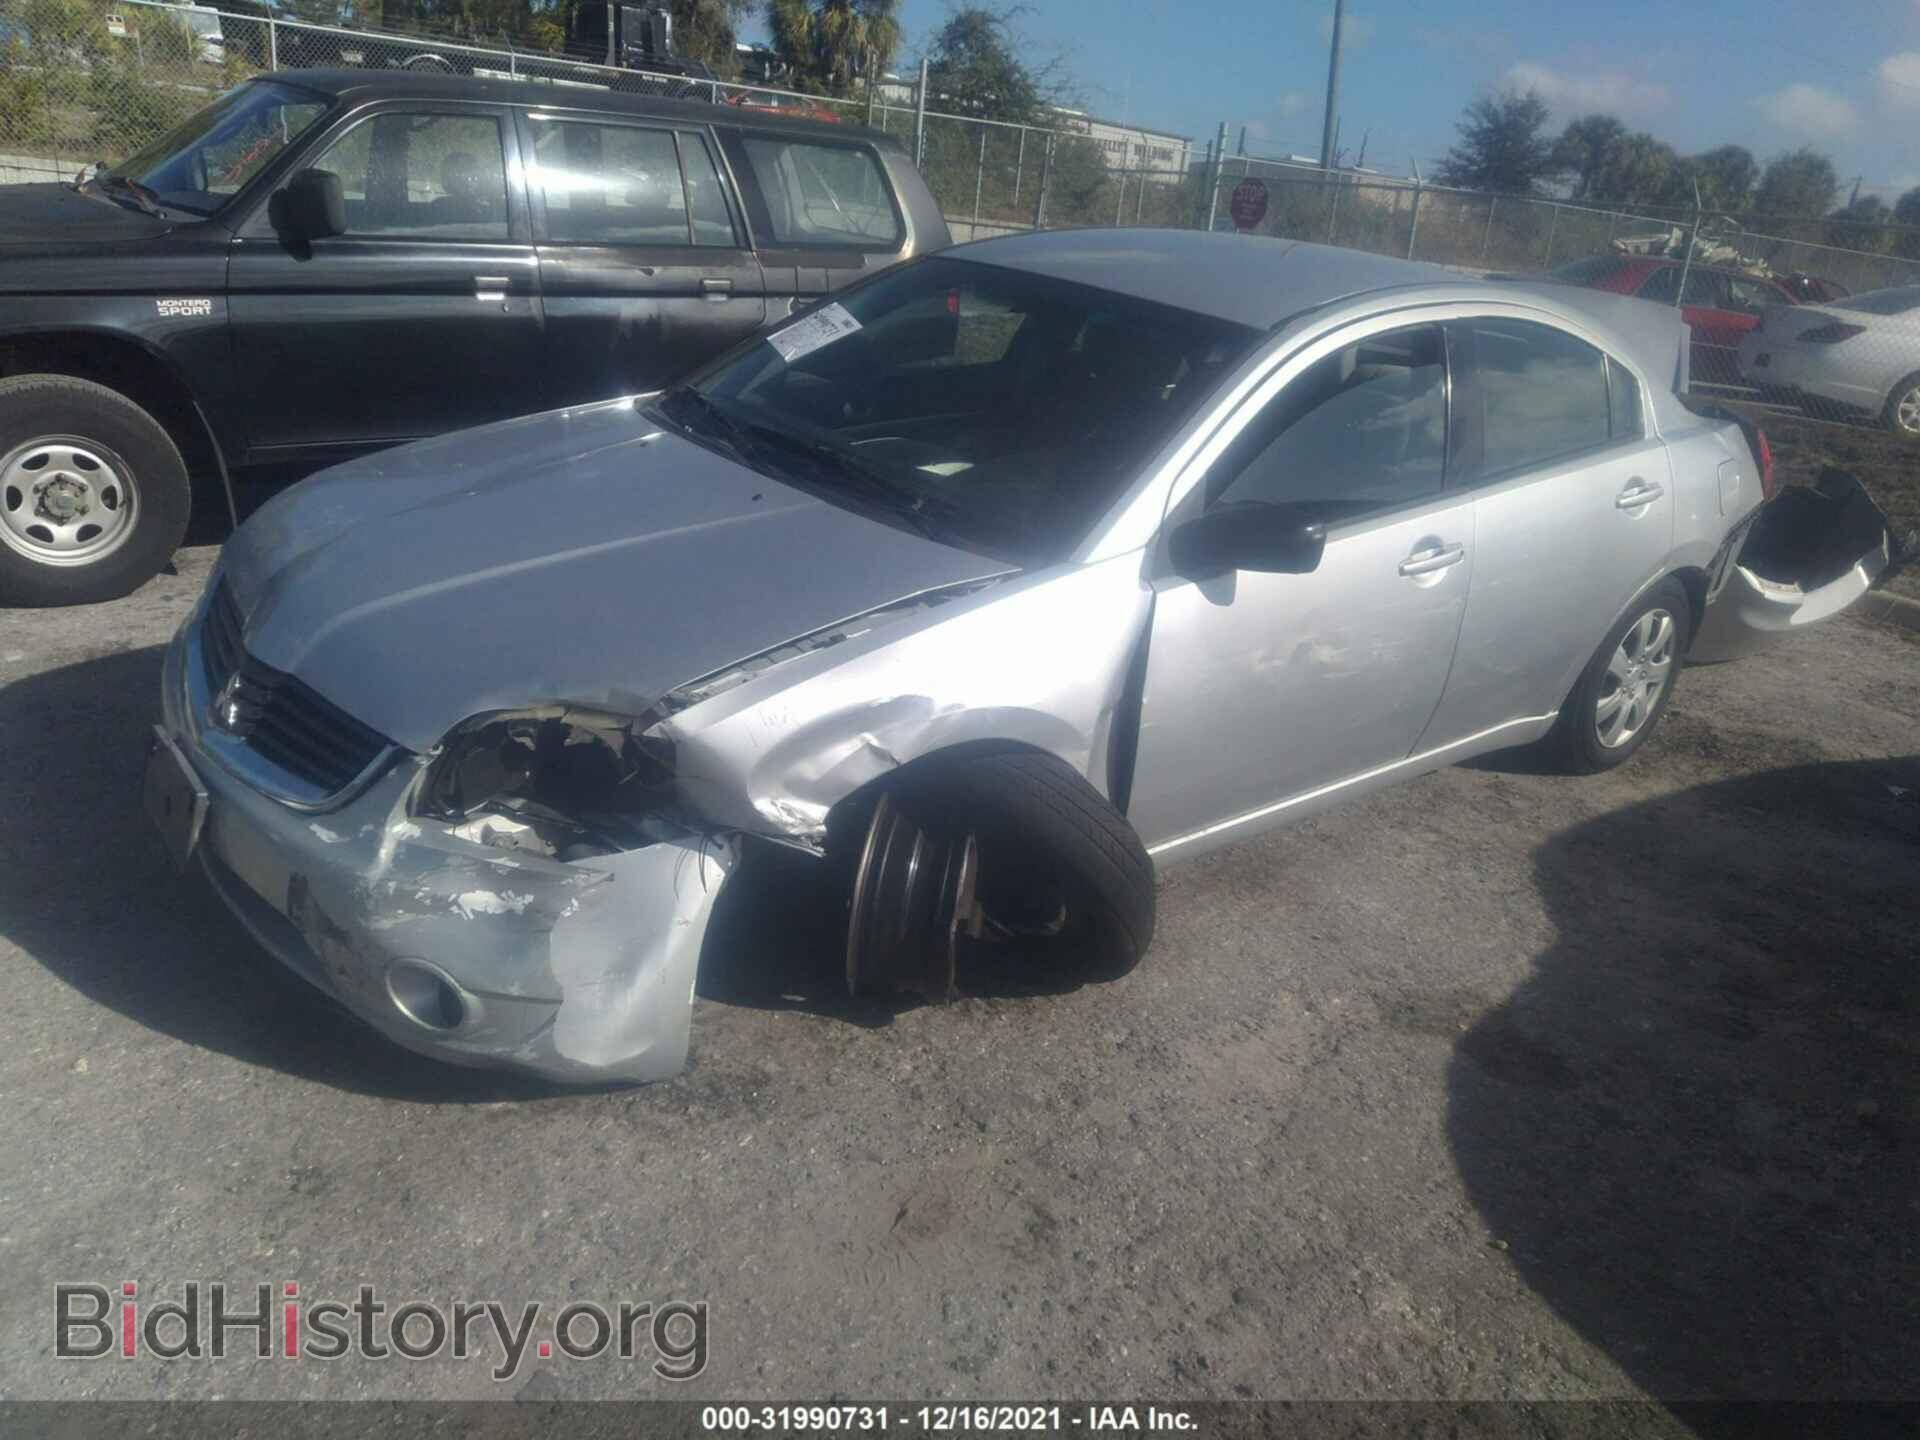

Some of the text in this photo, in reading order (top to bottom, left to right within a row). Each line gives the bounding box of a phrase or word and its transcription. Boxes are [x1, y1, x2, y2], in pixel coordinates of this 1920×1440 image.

[1234, 183, 1265, 202] STOP
[156, 299, 211, 307] MONTERO
[158, 306, 212, 316] SPORT
